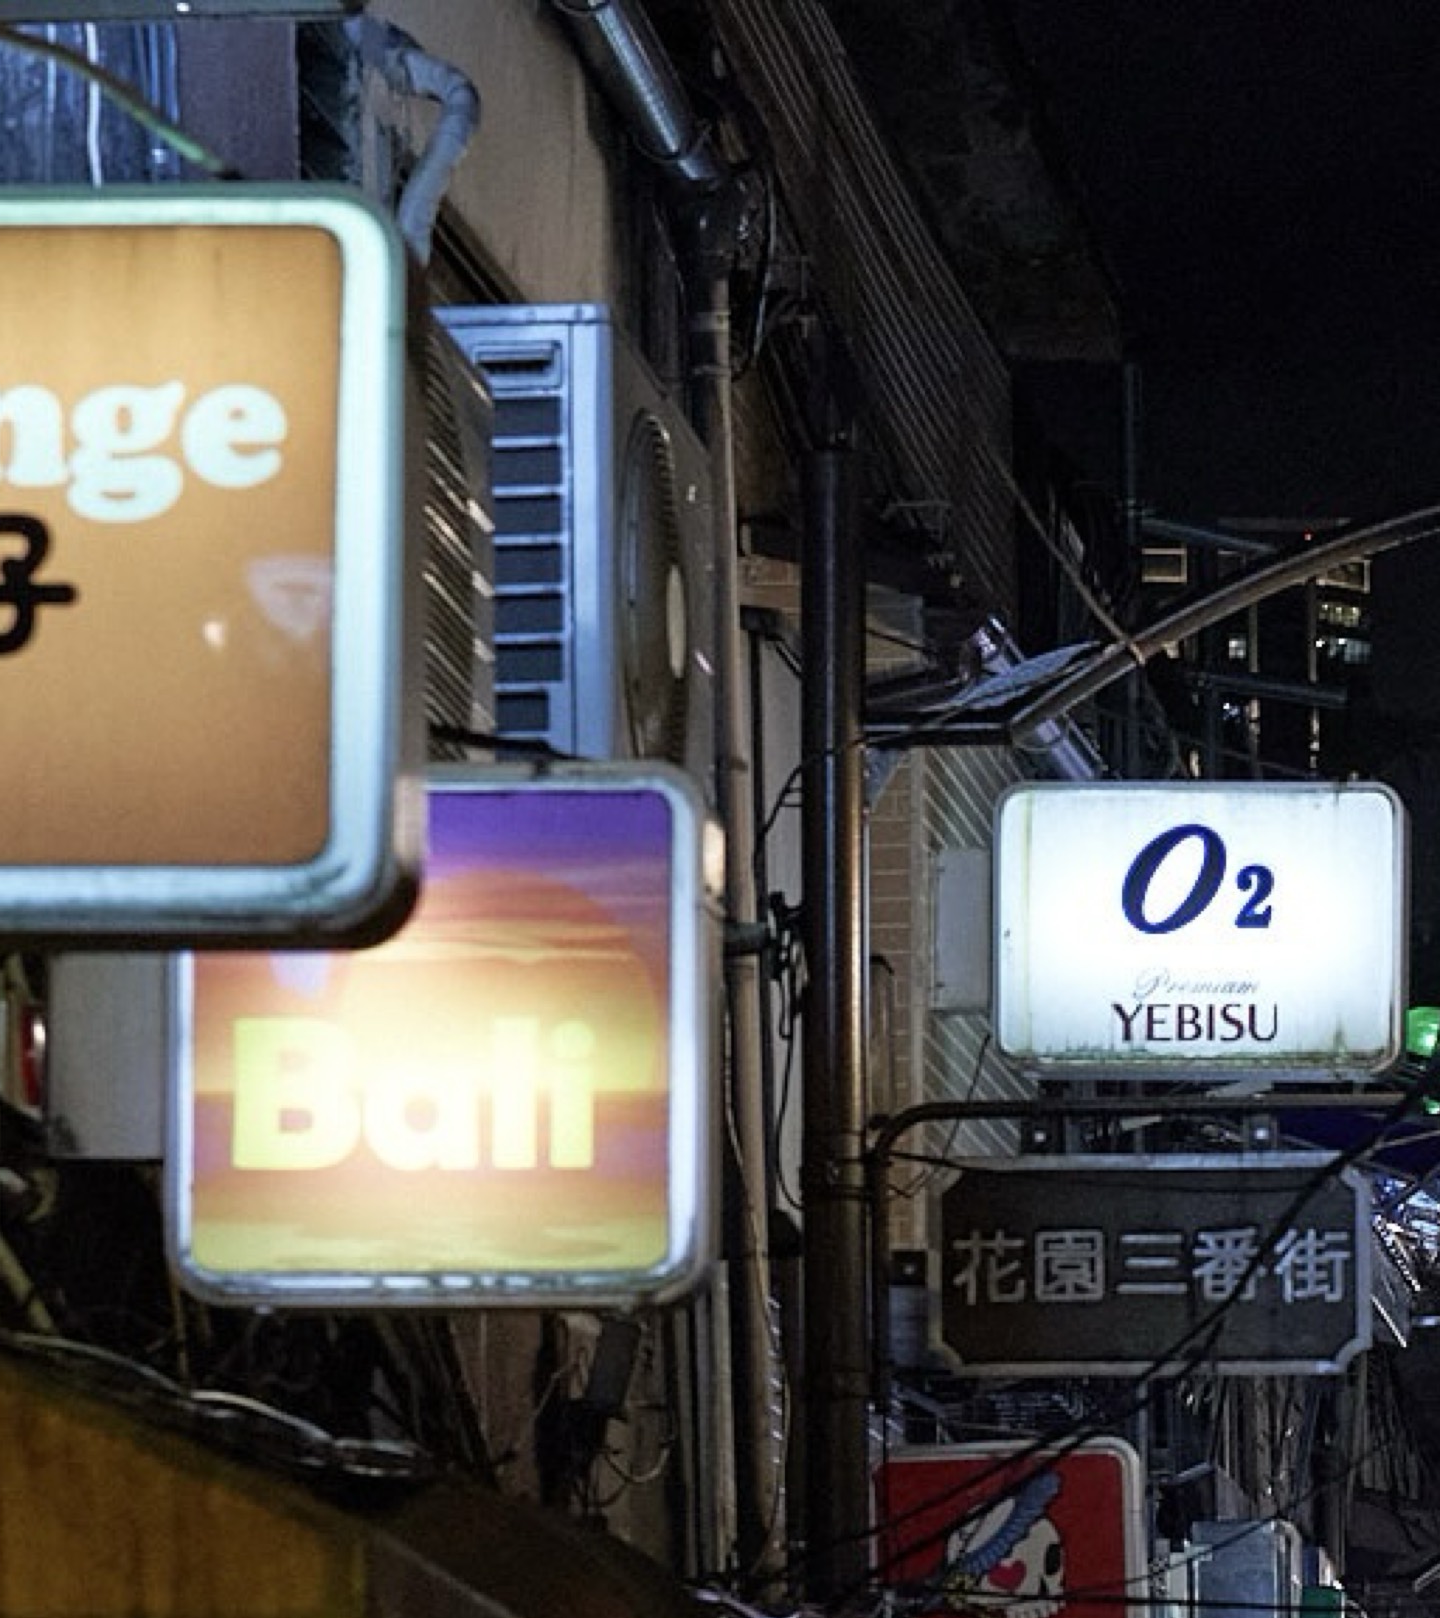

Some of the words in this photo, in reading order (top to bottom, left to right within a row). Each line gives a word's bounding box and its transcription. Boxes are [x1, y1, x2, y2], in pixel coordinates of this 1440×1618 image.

[1112, 1003, 1278, 1043] YEBISU
[231, 1014, 594, 1171] Bali
[953, 1229, 1350, 1305] 花園三番街
